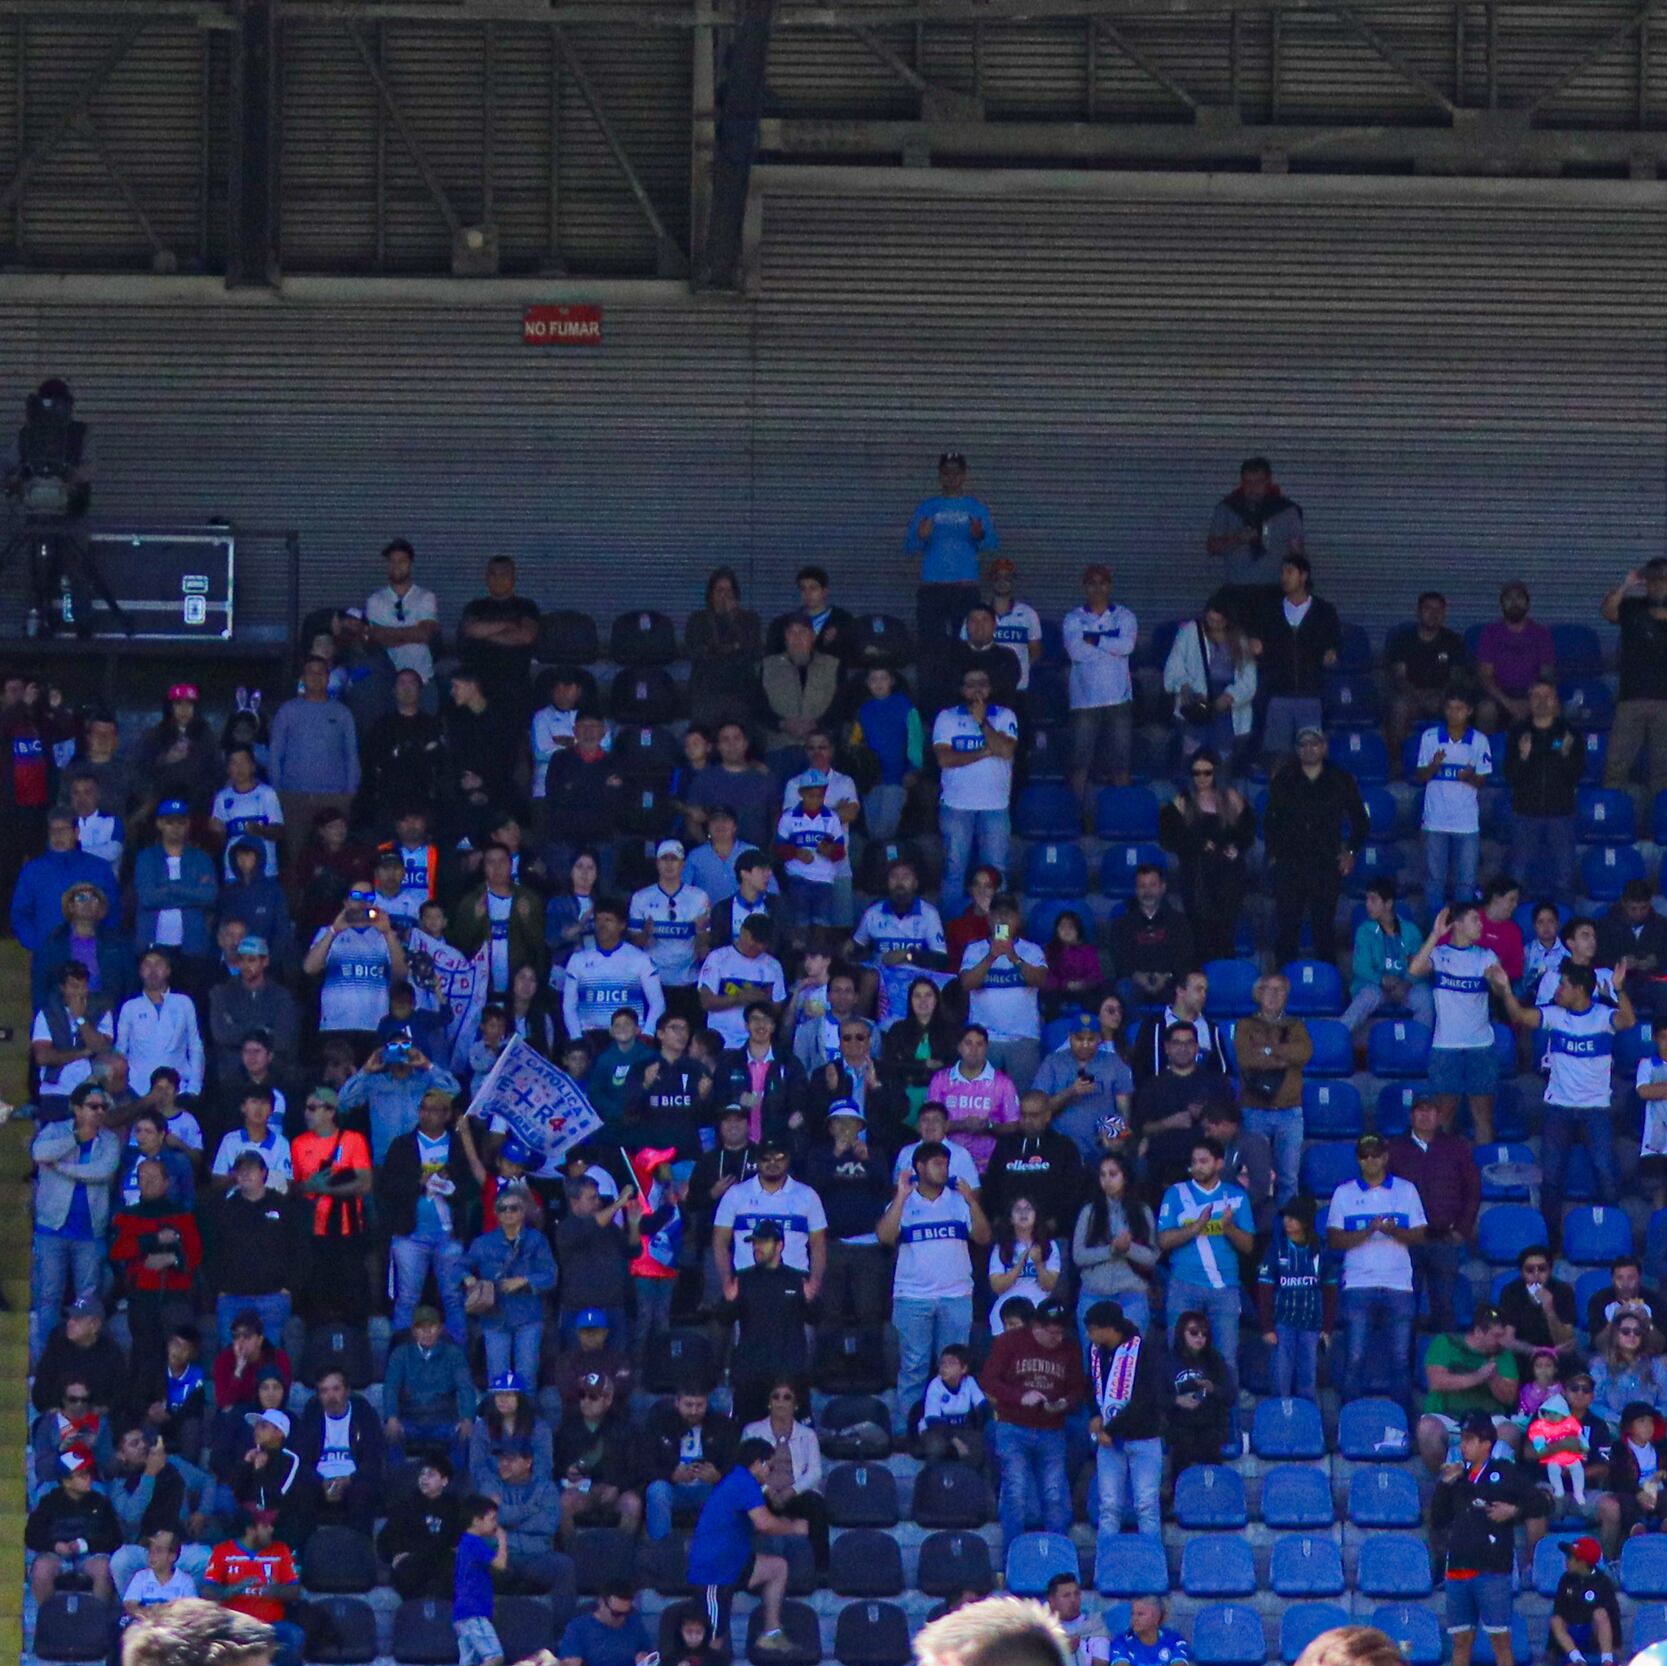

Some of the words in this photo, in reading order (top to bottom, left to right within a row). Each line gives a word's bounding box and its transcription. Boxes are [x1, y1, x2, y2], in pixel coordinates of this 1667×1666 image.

[525, 321, 546, 337] NO
[549, 321, 600, 337] FUMAR
[17, 739, 43, 753] BIC
[401, 871, 427, 885] BIC
[595, 989, 629, 1002] BICE
[1566, 1039, 1595, 1052] BICE
[660, 1094, 692, 1107] BICE
[959, 1095, 992, 1109] BICE
[1005, 1160, 1051, 1171] ellesse
[924, 1226, 956, 1239] BICE
